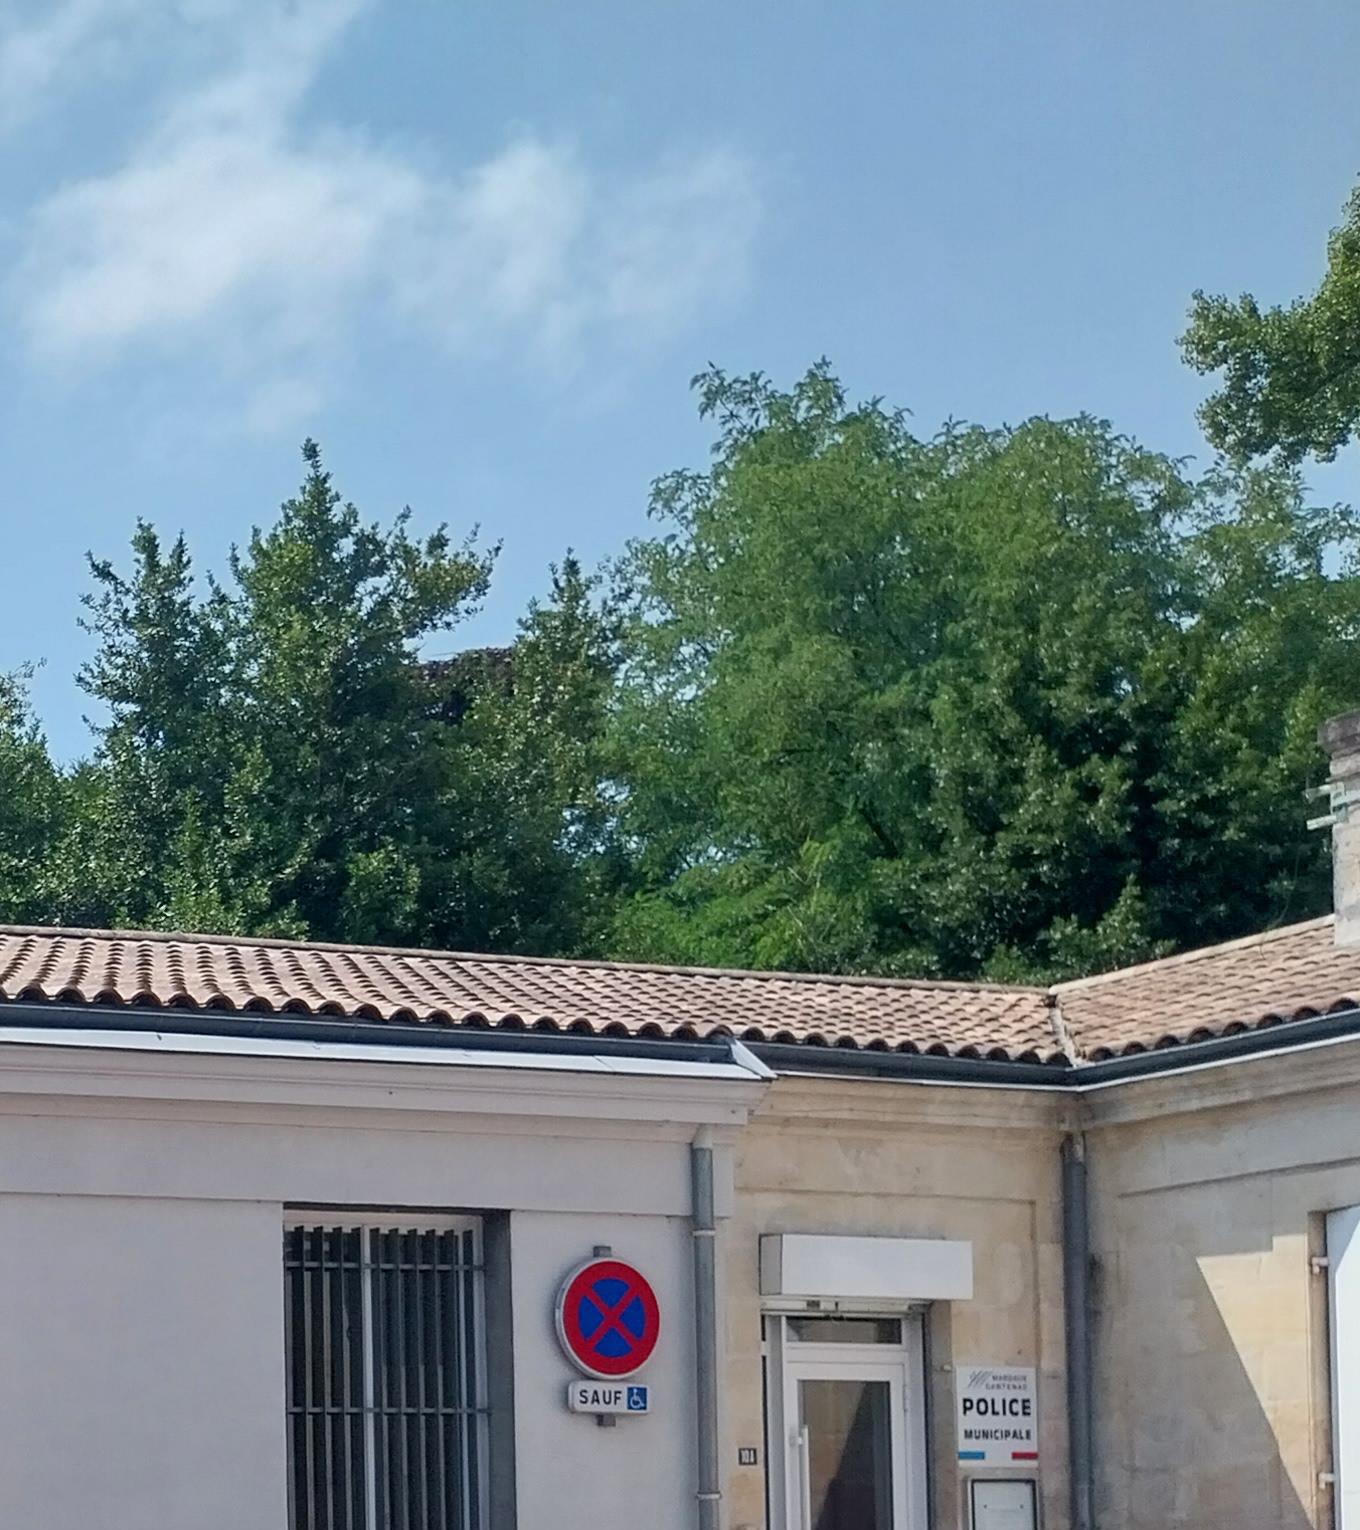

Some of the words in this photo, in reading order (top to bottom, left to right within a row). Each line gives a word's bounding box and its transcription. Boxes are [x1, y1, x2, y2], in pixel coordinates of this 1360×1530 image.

[579, 1389, 623, 1406] SAUF
[962, 1397, 1032, 1417] POLICE
[963, 1428, 1032, 1441] MUNICIPALE
